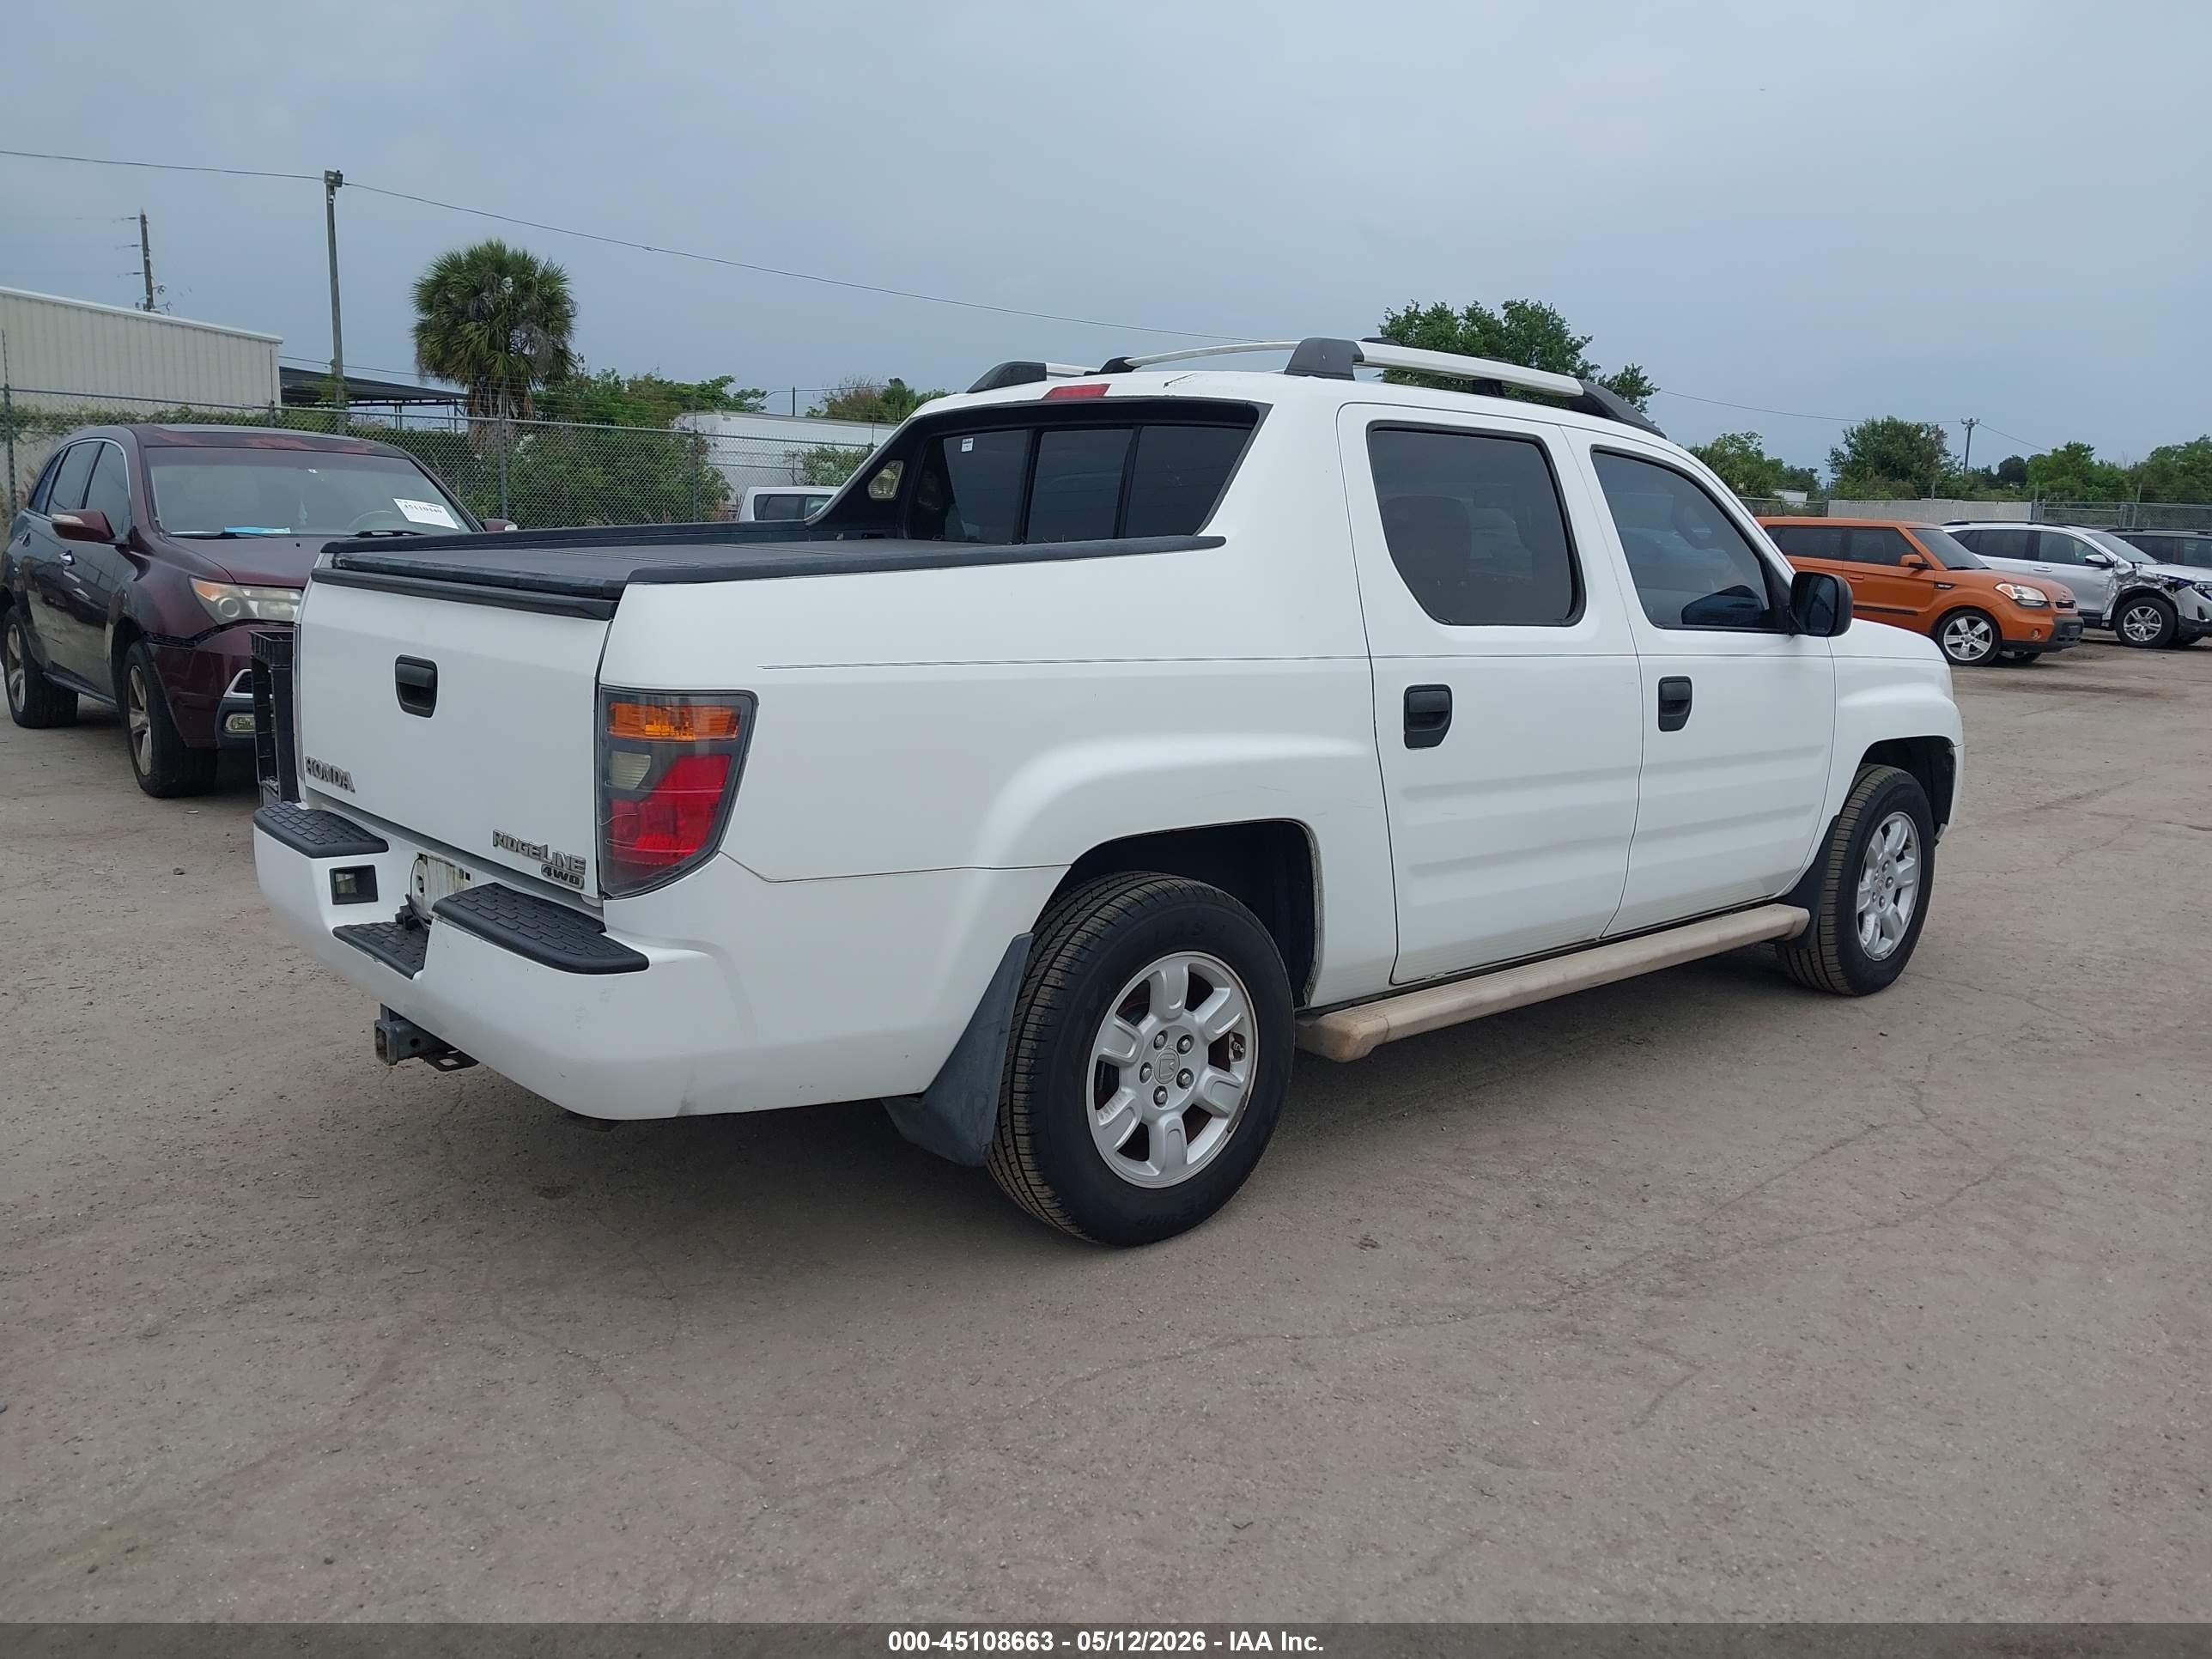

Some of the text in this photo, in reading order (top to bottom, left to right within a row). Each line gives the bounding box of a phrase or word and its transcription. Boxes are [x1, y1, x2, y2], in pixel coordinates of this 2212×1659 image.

[305, 756, 356, 793] HONDA
[493, 830, 586, 875] RIDGELINE
[542, 865, 581, 887] 4WD
